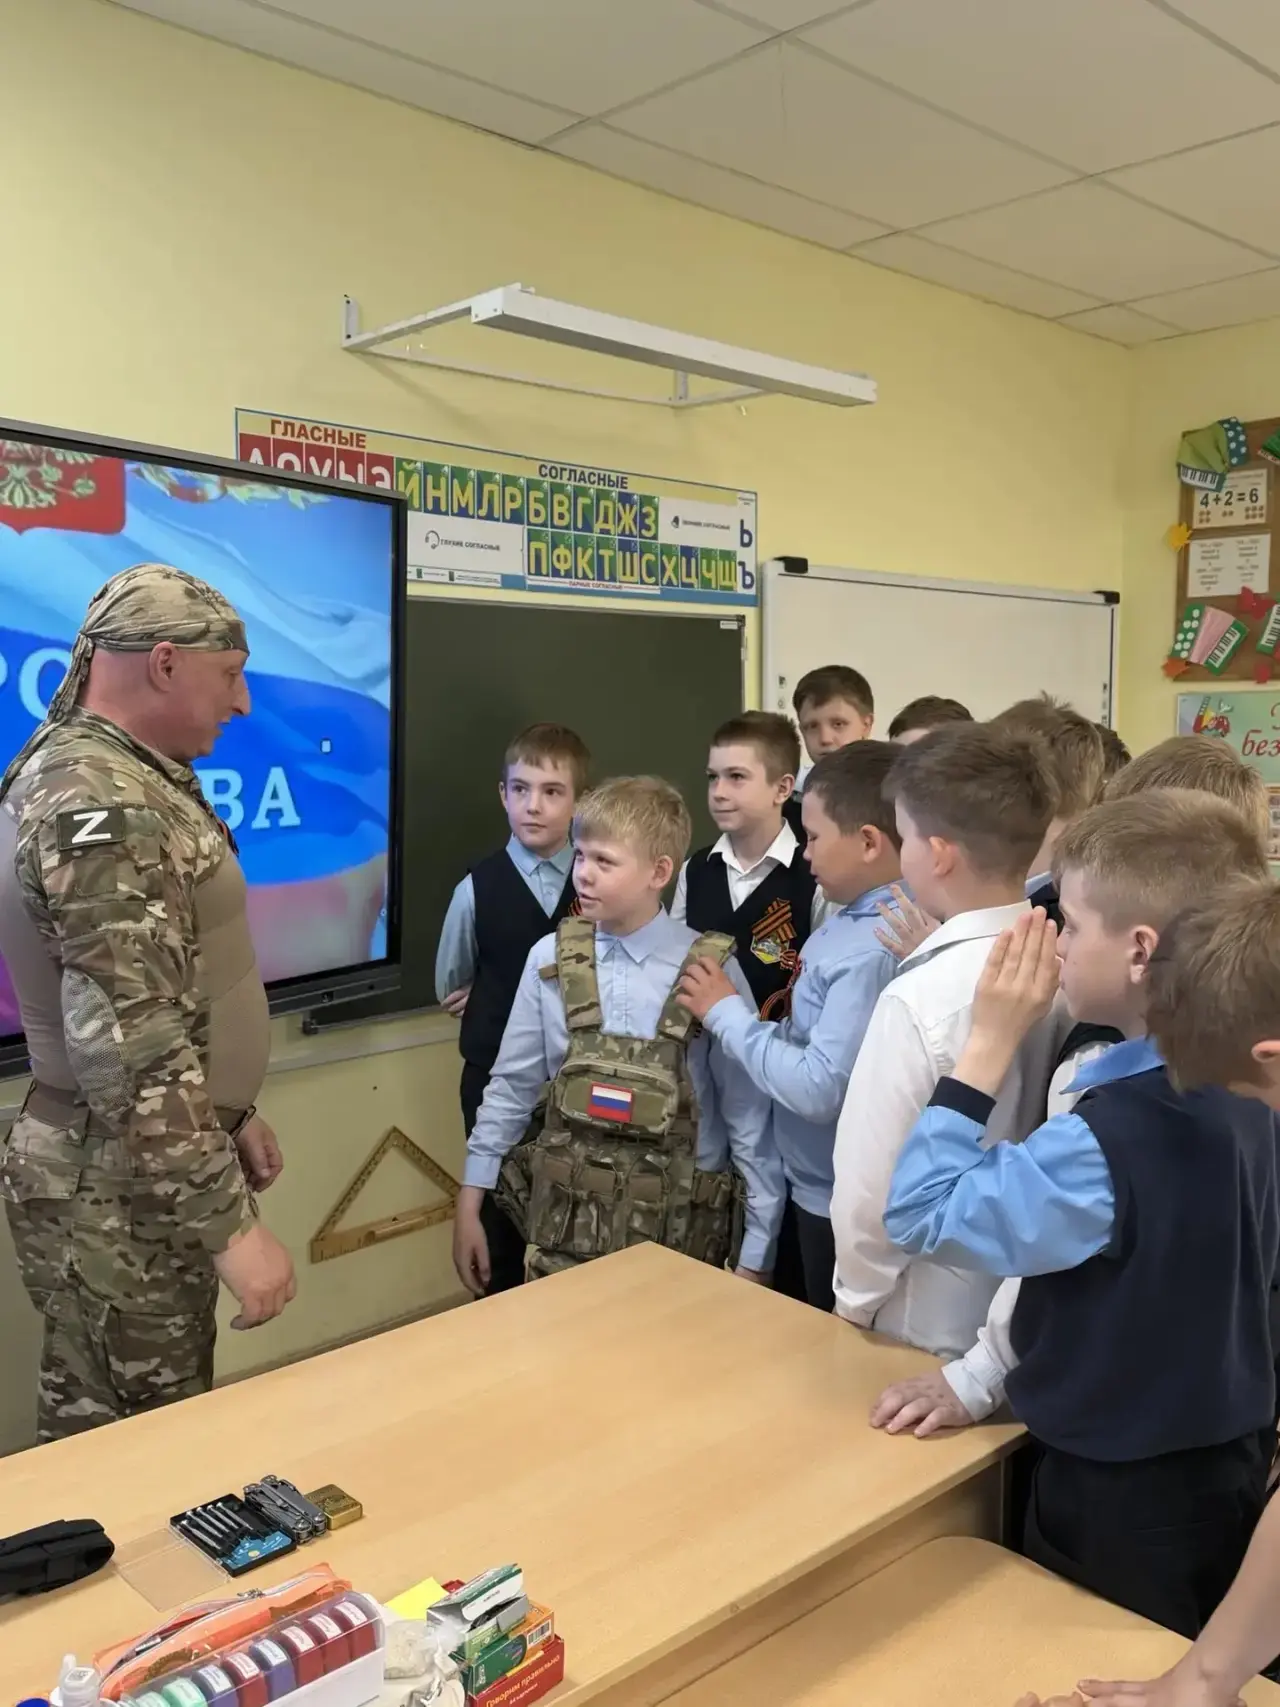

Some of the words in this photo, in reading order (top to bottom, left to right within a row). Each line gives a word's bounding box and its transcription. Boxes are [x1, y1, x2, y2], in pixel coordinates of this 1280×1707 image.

[270, 419, 367, 449] ГЛАСНЫЕ
[538, 463, 629, 490] СОГЛАСНЫЕ
[1200, 492, 1209, 508] 4
[1224, 490, 1233, 506] 2
[1249, 487, 1259, 504] 6
[71, 810, 112, 844] Z
